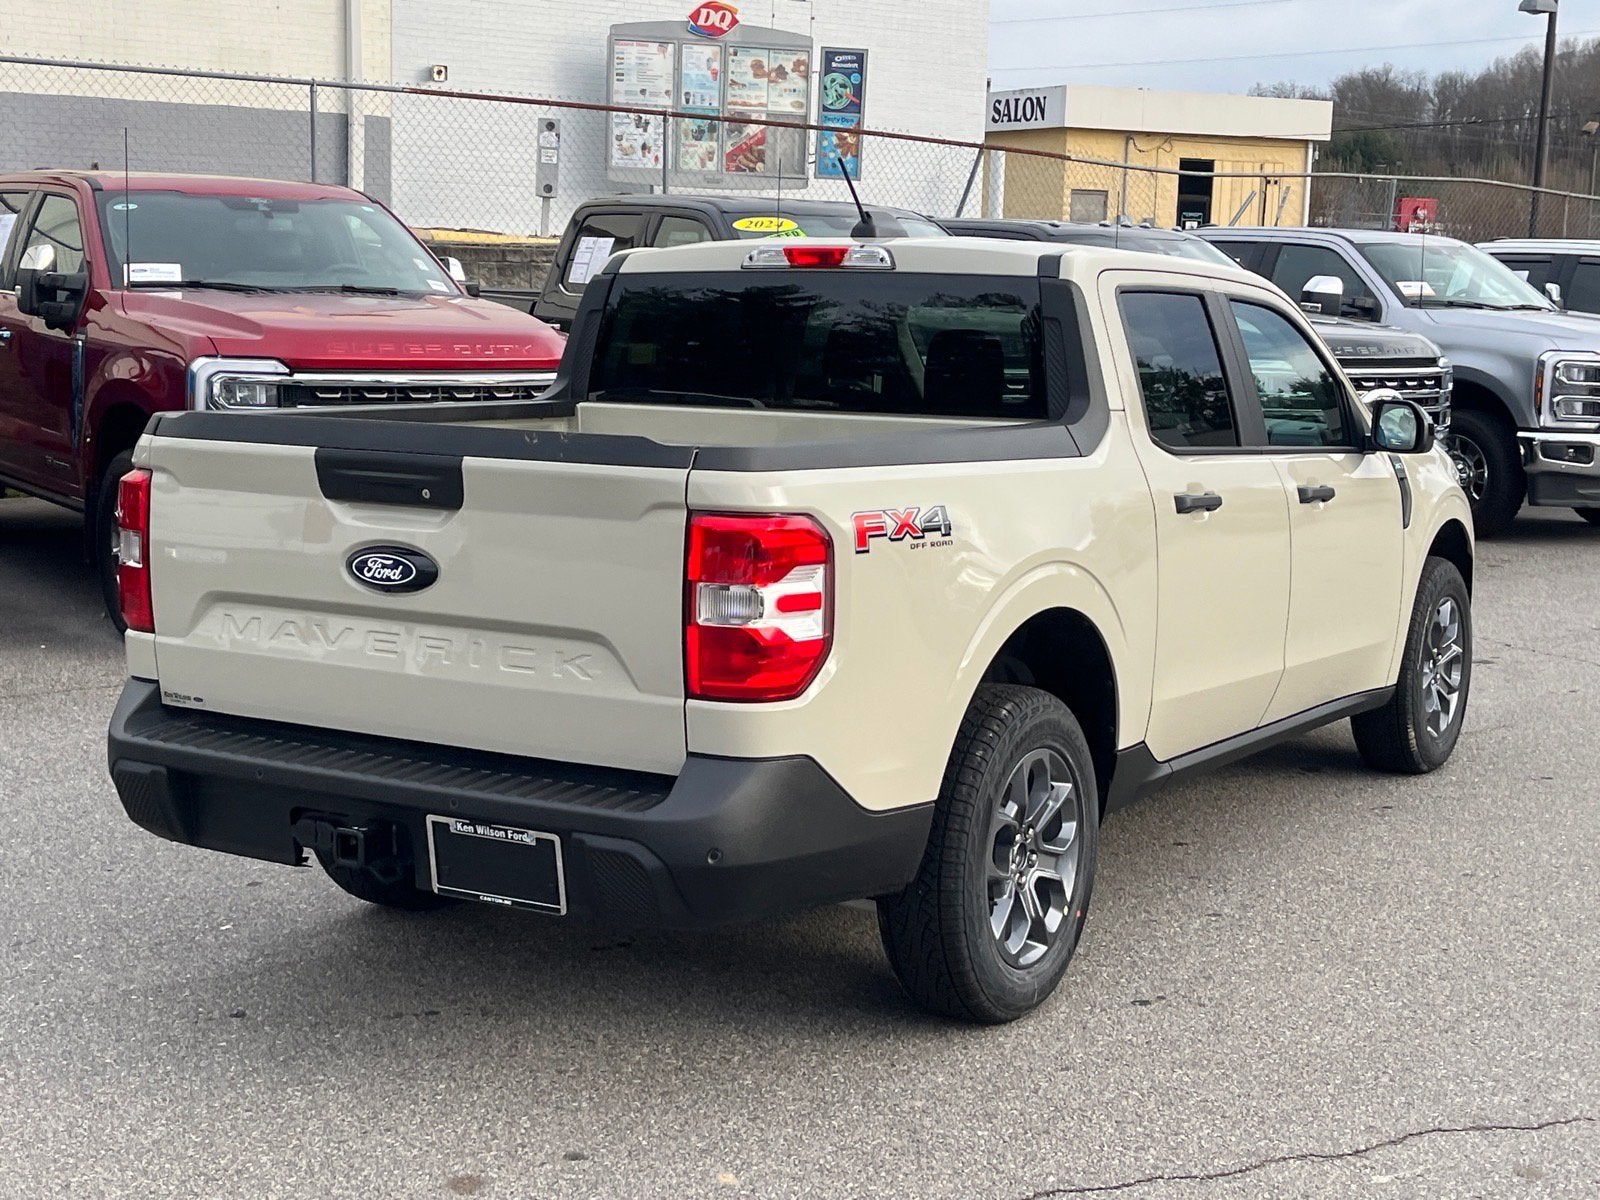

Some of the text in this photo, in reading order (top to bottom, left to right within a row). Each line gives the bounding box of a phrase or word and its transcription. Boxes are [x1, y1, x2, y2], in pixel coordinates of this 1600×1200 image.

[696, 8, 733, 31] DQ
[991, 96, 1047, 124] SALON
[744, 220, 785, 229] 2024
[326, 342, 532, 354] SUPER DUTY
[850, 505, 952, 554] FX4
[910, 539, 954, 550] OFF ROAD
[363, 557, 404, 580] Ford
[216, 613, 600, 681] MAVERICK
[456, 821, 530, 842] Ken Wilson Ford
